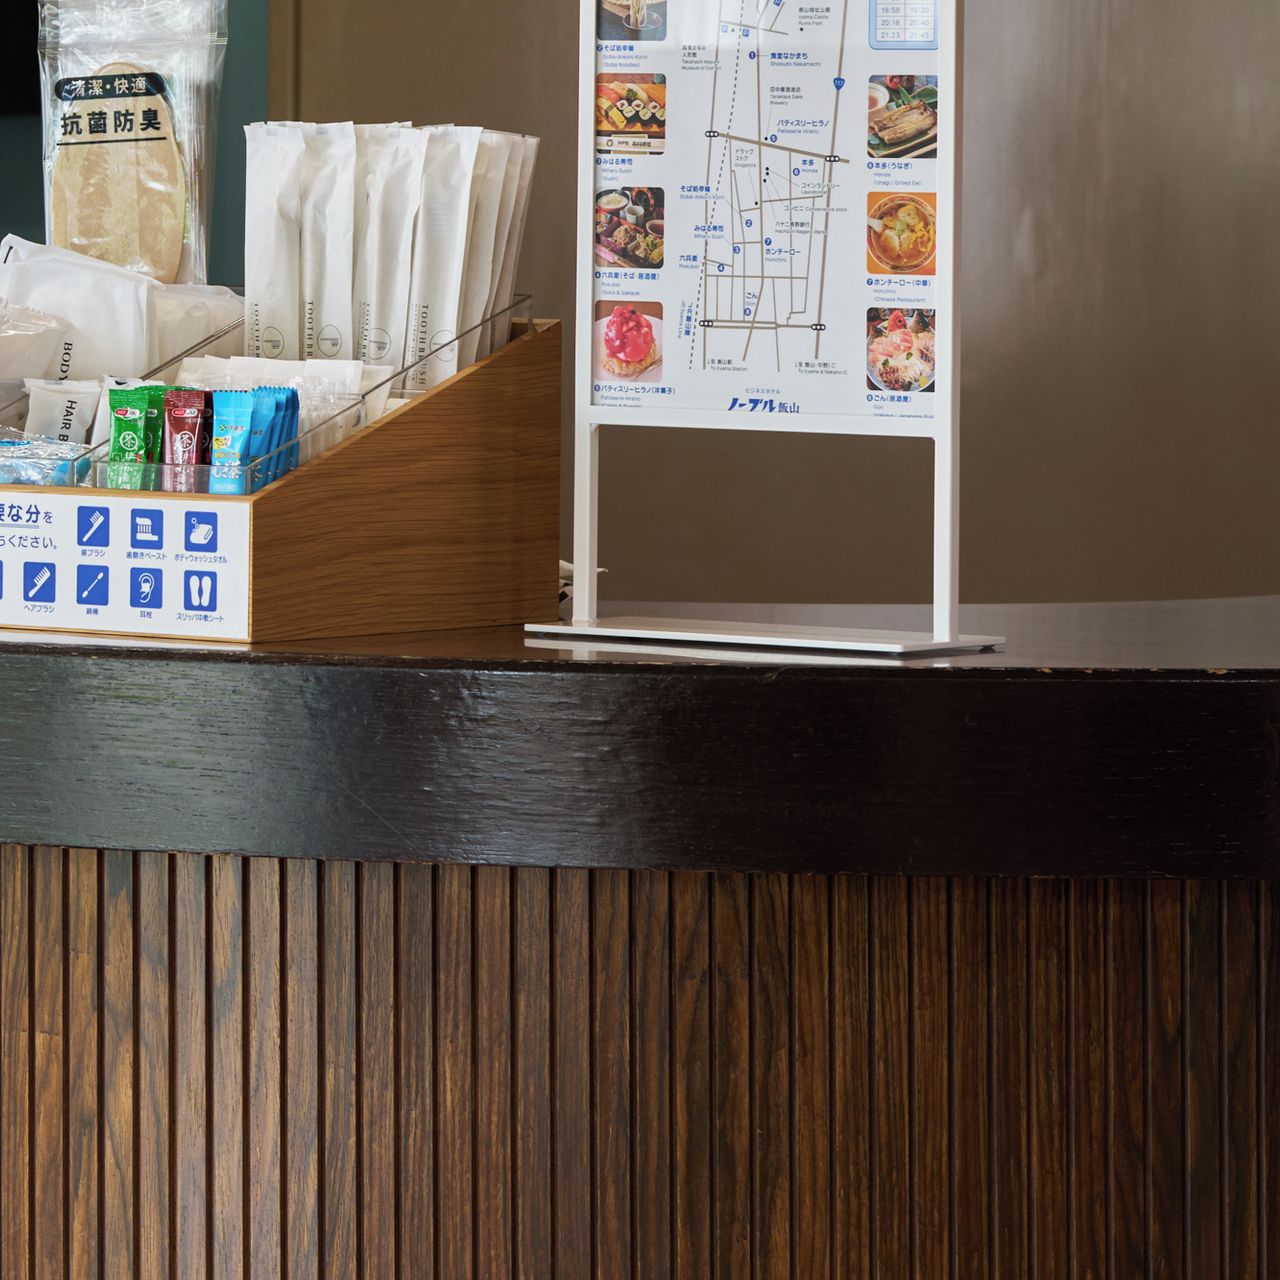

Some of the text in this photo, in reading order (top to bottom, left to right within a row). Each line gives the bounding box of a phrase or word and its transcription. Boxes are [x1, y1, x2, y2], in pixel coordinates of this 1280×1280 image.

[71, 76, 147, 97] 清潔・快適
[60, 108, 161, 136] 抗菌防臭
[777, 119, 830, 127] パティスリーヒラノ
[602, 158, 633, 166] みはる寿司
[61, 400, 77, 430] HAIR
[81, 549, 106, 558] 歯ブラシ
[126, 551, 168, 561] 歯磨きペースト
[23, 605, 55, 614] ヘアブラシ
[140, 610, 153, 619] 耳栓
[176, 612, 225, 623] スリッパ中敷シート
